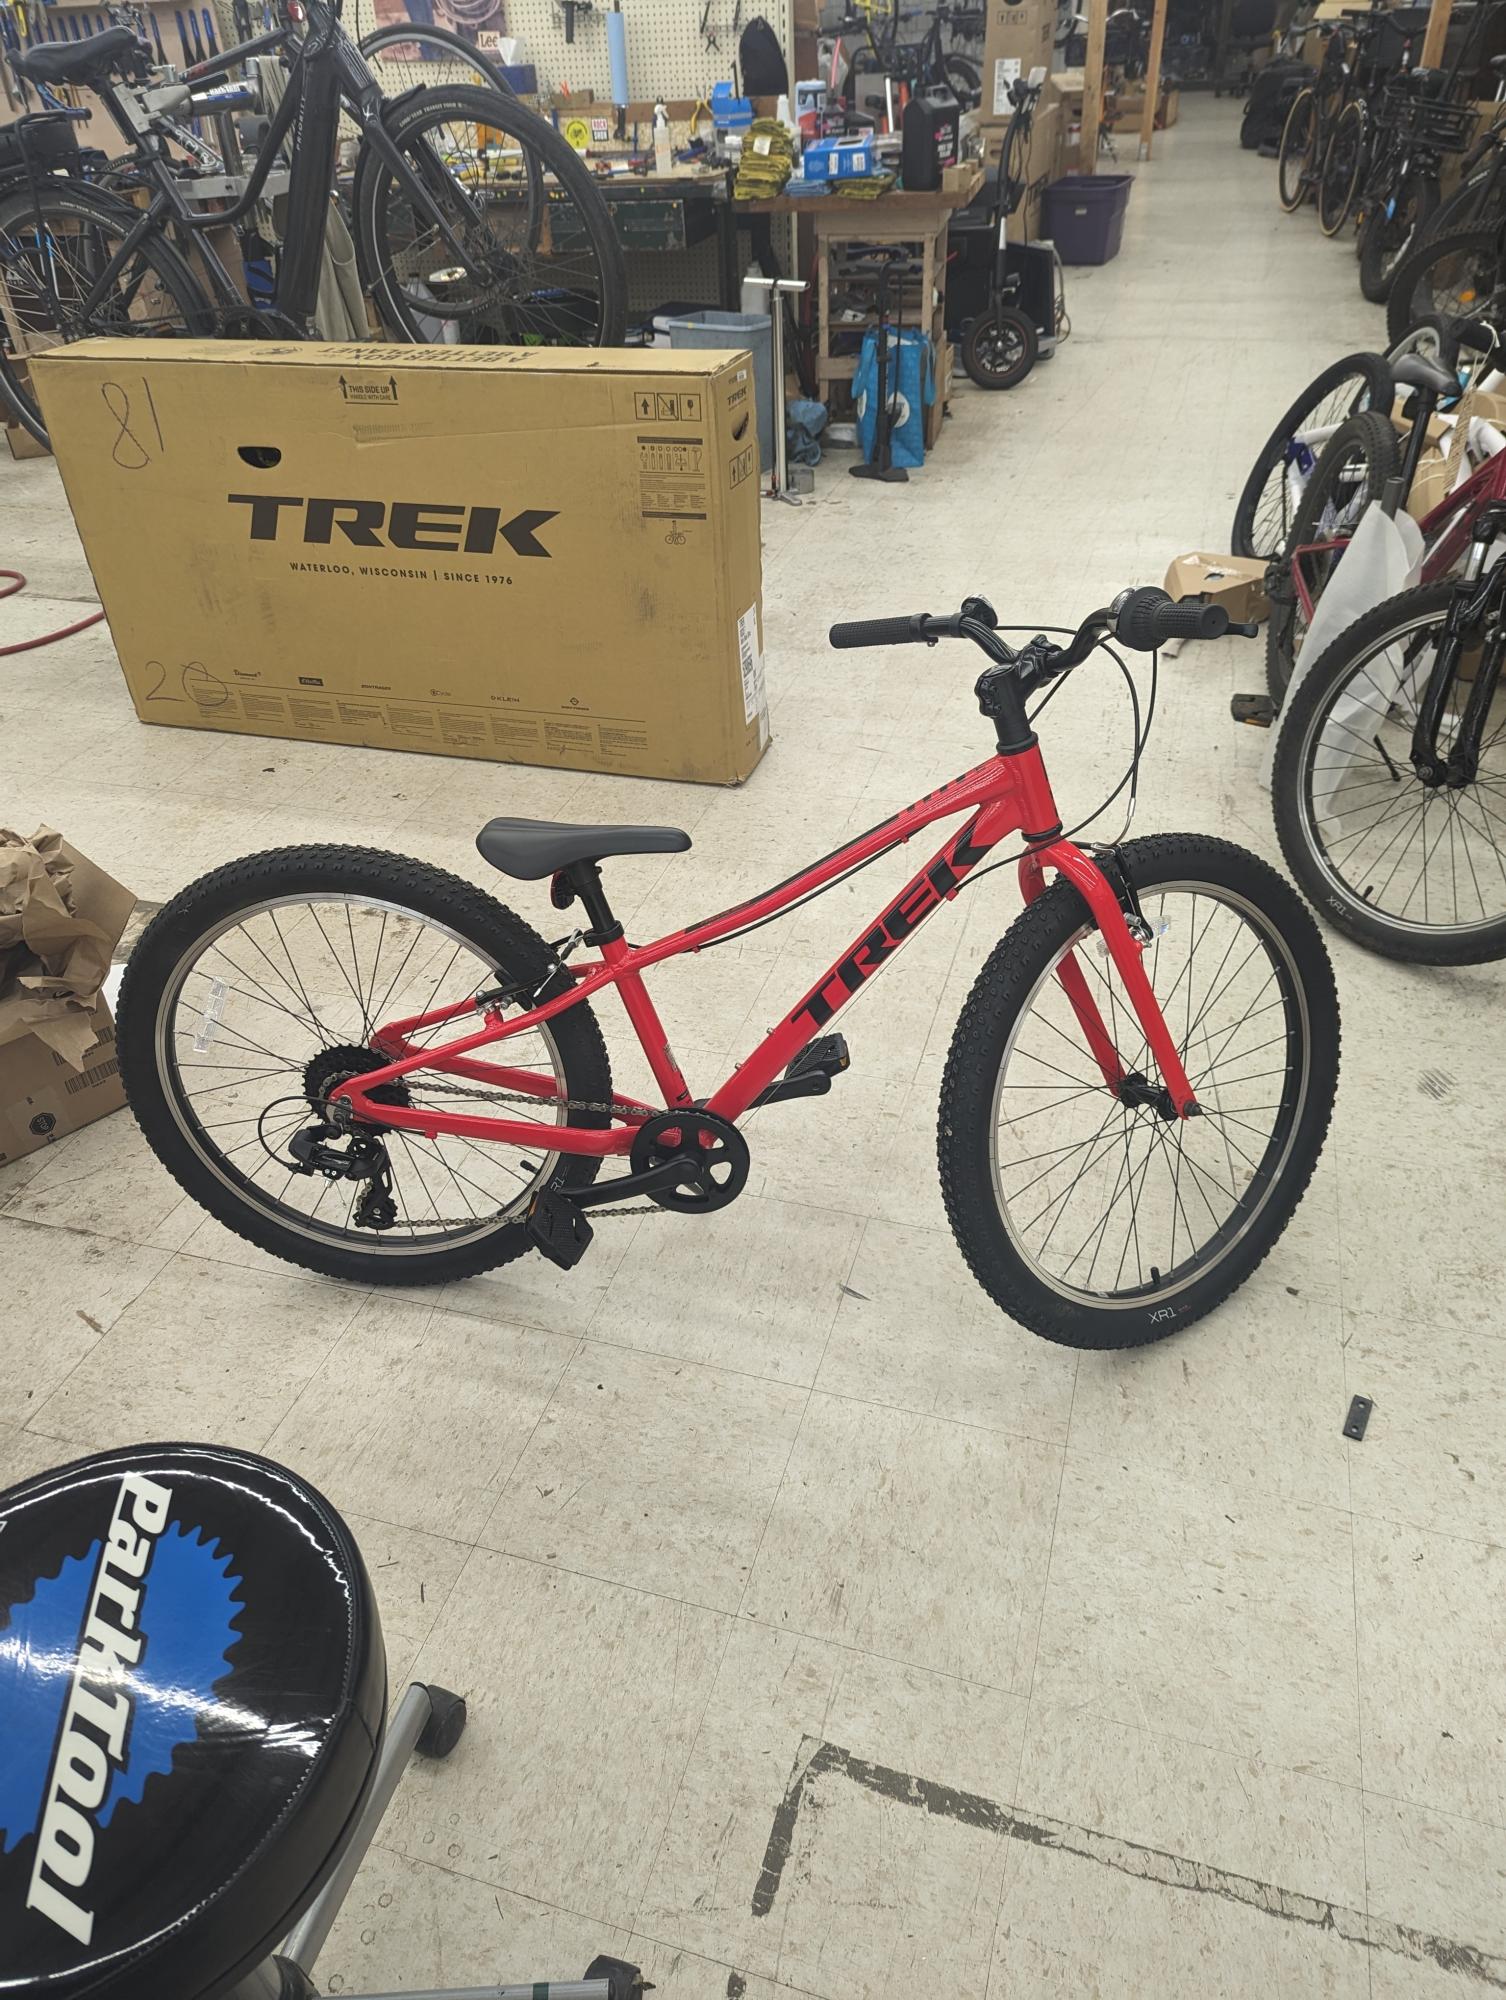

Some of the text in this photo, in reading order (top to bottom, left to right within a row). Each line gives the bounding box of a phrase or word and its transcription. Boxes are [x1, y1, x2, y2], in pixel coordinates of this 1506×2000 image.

[480, 33, 498, 48] Lee
[349, 385, 390, 394] THIS SIDE UP
[228, 493, 561, 559] TREK
[289, 561, 513, 586] WATERLOO, WISCONSIN SINCE 1976
[791, 820, 995, 1027] TREK
[1148, 1306, 1177, 1325] XR1
